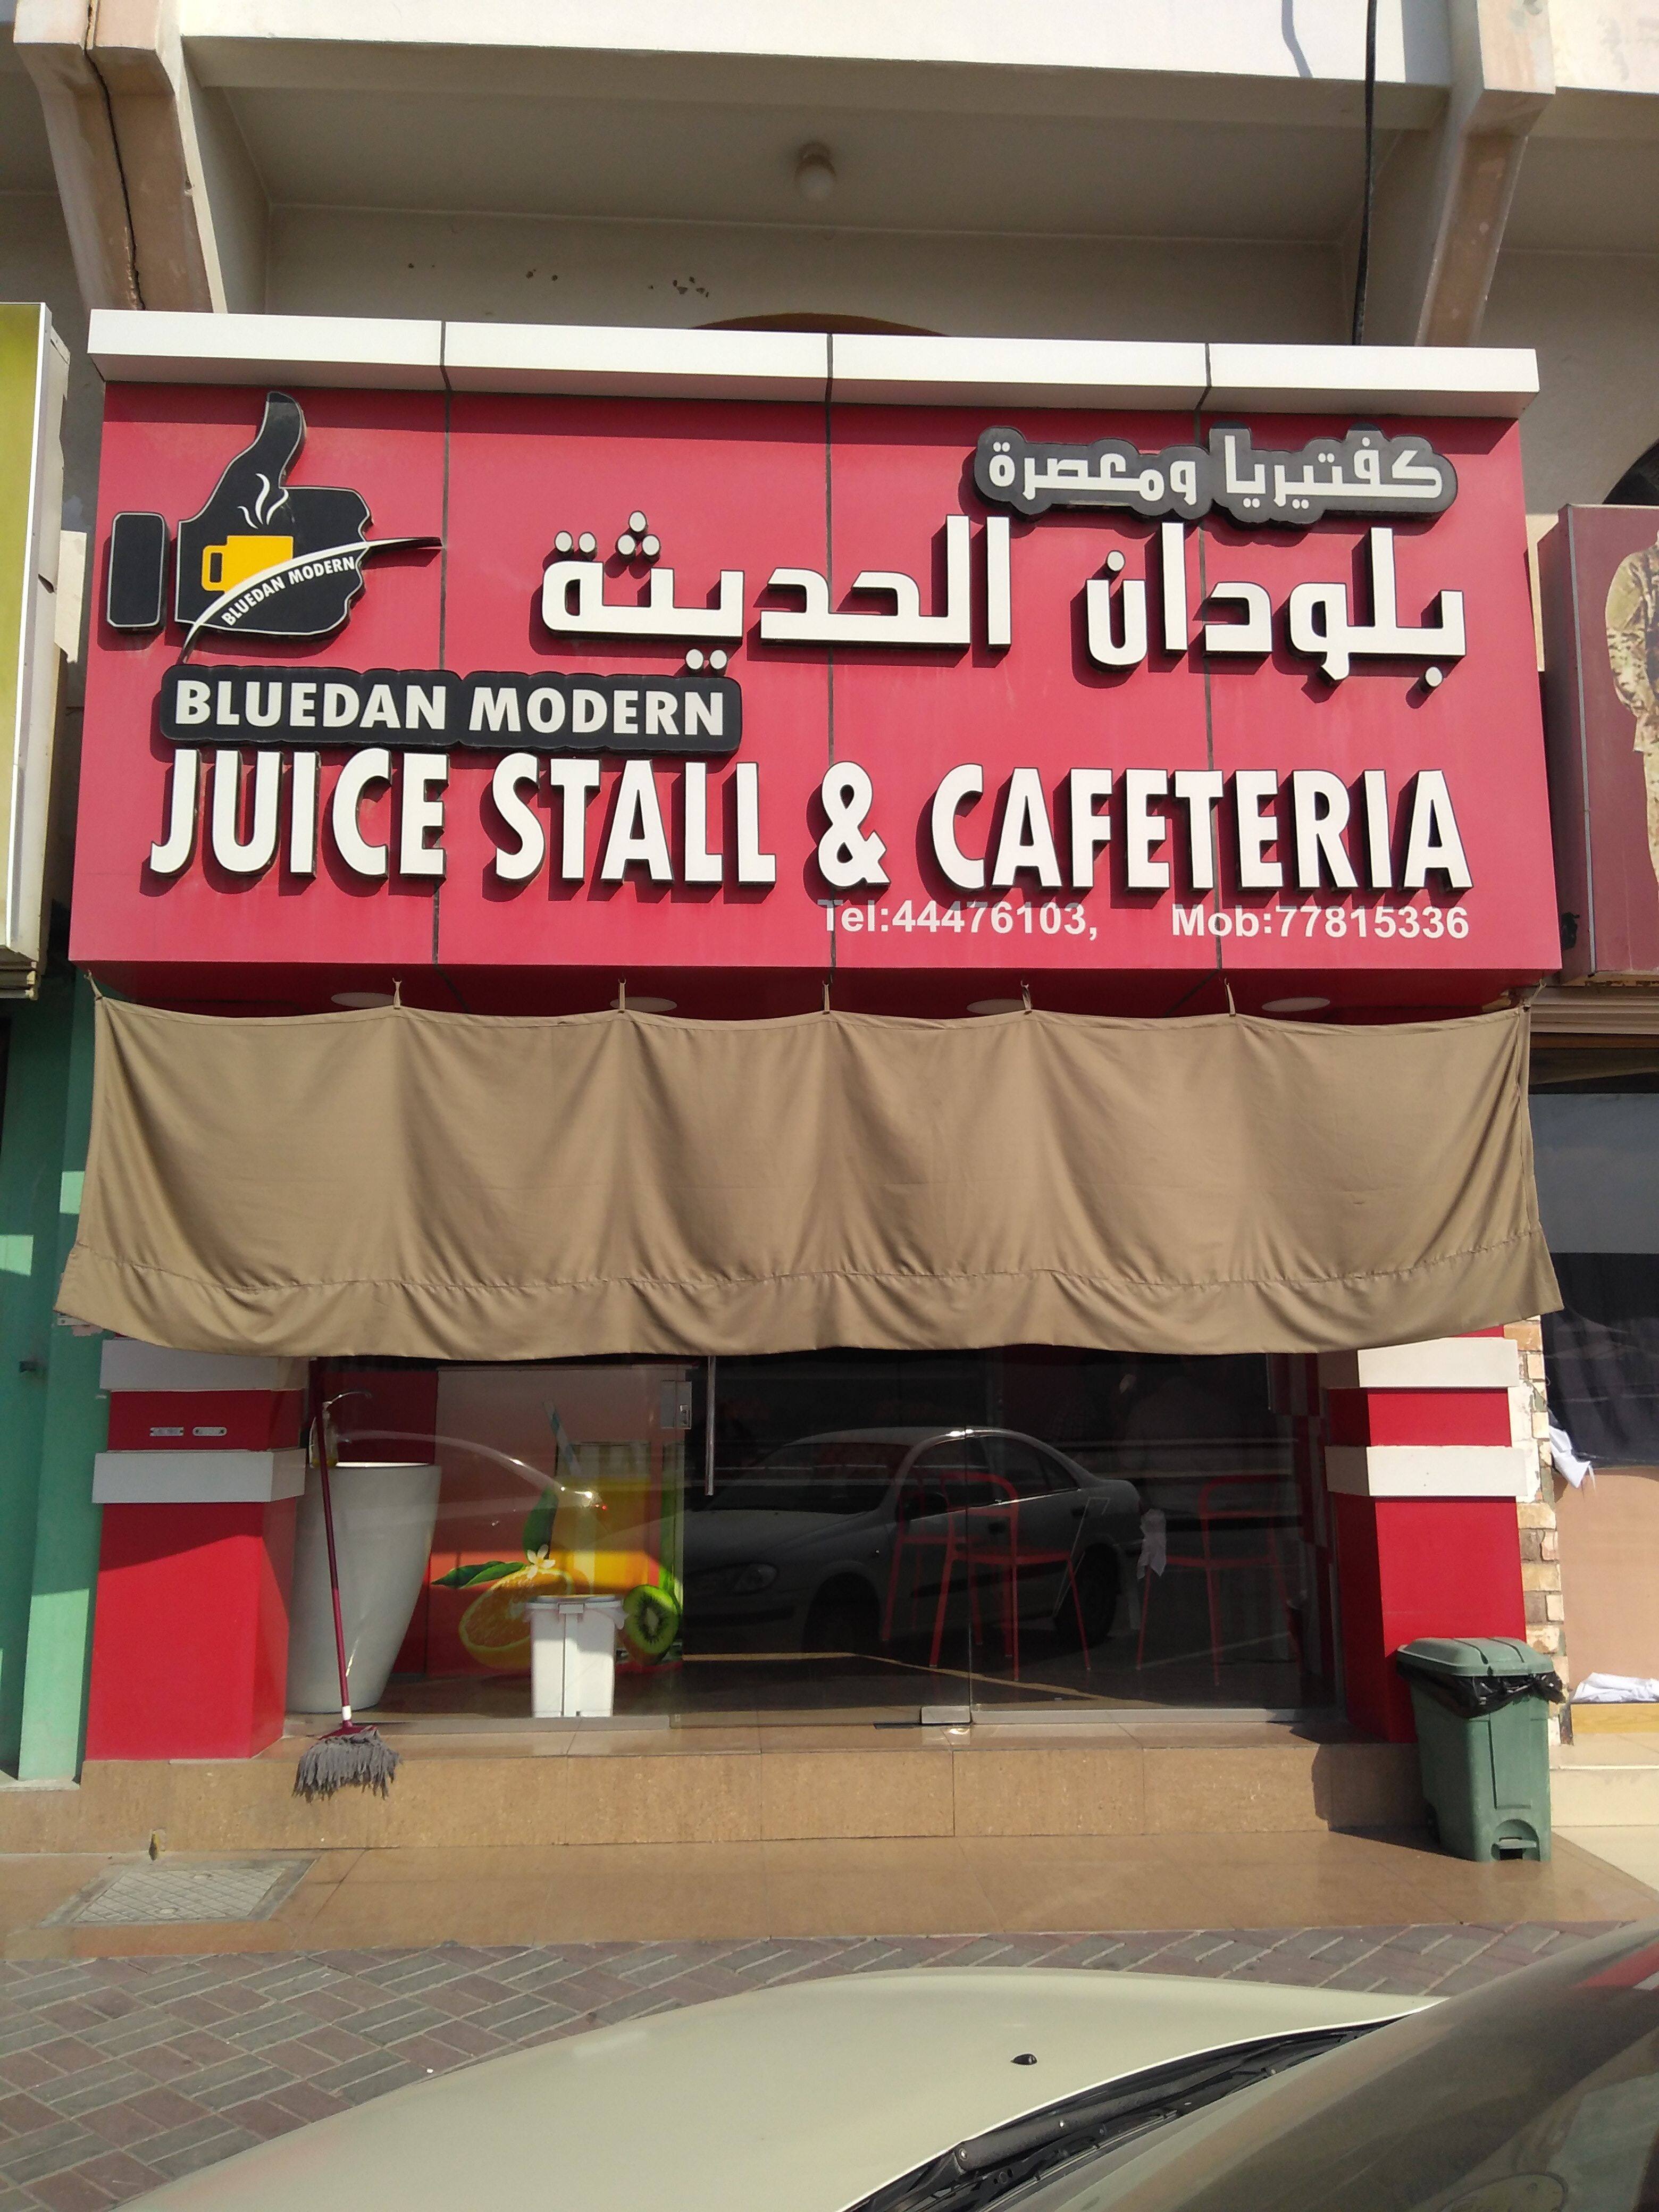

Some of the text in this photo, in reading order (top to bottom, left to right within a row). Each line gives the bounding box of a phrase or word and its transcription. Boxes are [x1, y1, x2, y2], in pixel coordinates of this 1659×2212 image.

[988, 435, 1443, 509] كفتيريا ومعصرة
[221, 556, 355, 626] BLUEDAN MODERN
[542, 510, 1467, 688] بلودان الحديثة
[175, 681, 724, 736] BLUEDAN MODERN
[149, 748, 1474, 891] JUICE STALL & CAFETERIA
[817, 900, 1470, 941] Tel:44476103, Mob:77815336
